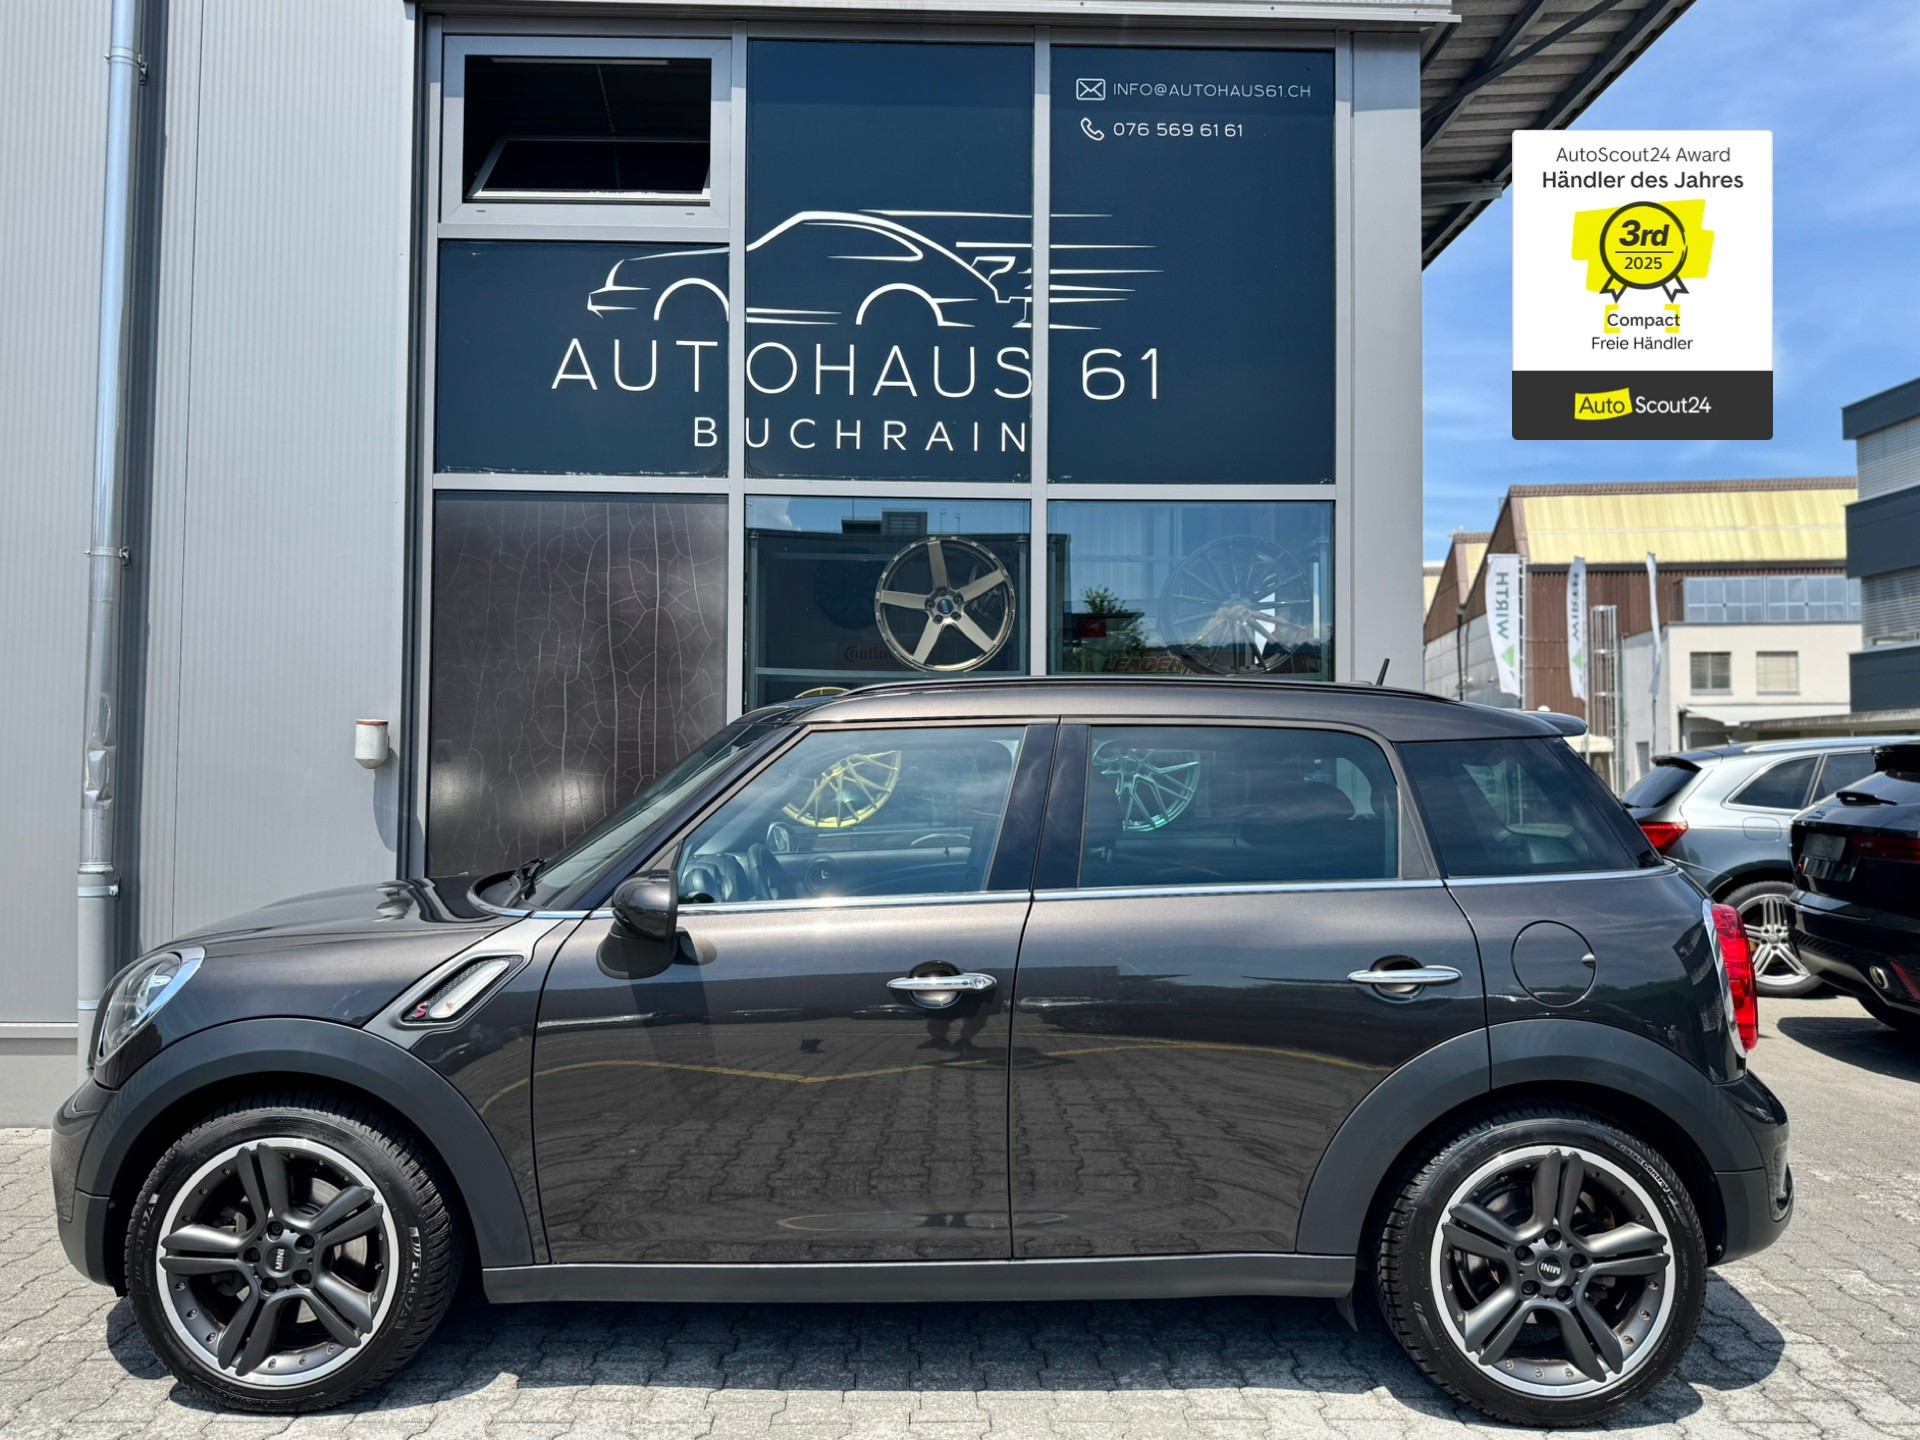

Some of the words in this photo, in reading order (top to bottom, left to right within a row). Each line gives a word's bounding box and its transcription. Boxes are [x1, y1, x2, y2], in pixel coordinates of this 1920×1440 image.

[1113, 83, 1312, 99] INFO@AUTOHAUS61.CH
[1113, 122, 1150, 138] 076
[1156, 122, 1194, 138] 569
[1200, 123, 1219, 138] 61
[1224, 123, 1244, 138] 61
[551, 337, 1031, 400] AUTOHAUS
[1082, 347, 1159, 401] 61
[693, 415, 1027, 454] BUCHRAIN
[411, 1001, 428, 1019] S
[275, 1248, 285, 1270] MINI
[1540, 1262, 1561, 1275] MINI
